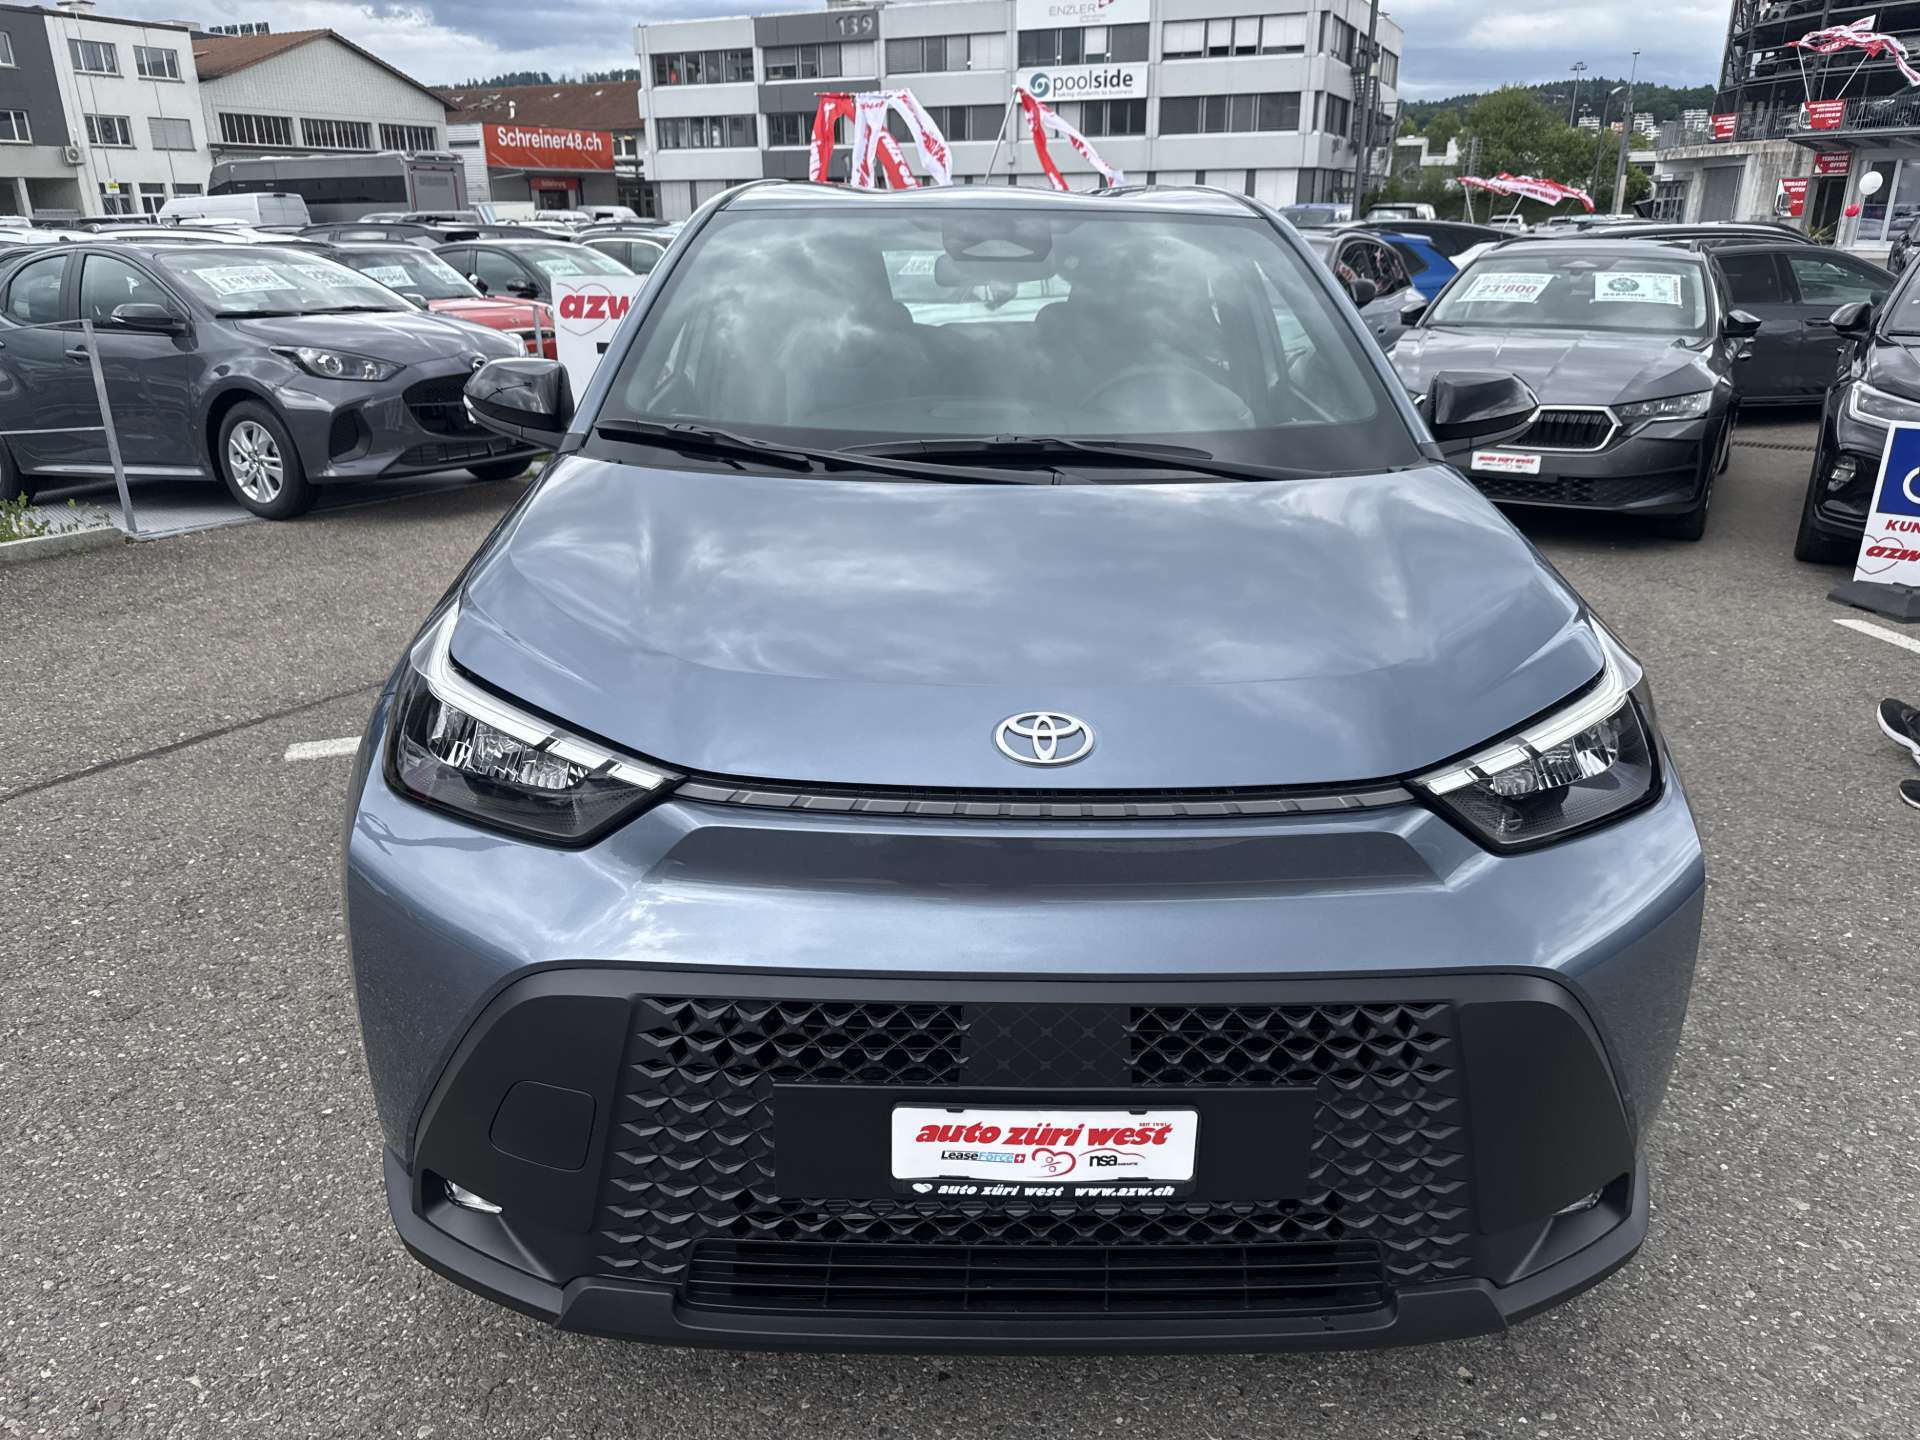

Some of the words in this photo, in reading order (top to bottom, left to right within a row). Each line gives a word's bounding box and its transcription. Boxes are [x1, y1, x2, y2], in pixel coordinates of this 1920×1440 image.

[1048, 3, 1096, 17] ENZLER
[836, 15, 873, 36] 139
[1053, 69, 1133, 97] poolside
[498, 127, 602, 151] Schreiner48.ch
[915, 1121, 1001, 1144] auto
[1001, 1122, 1085, 1146] züri
[1088, 1123, 1173, 1146] west
[941, 1150, 1014, 1163] LeaseForce
[1089, 1155, 1118, 1167] nsa
[938, 1185, 978, 1195] auto
[981, 1184, 1020, 1196] züri
[1024, 1186, 1064, 1197] west
[1074, 1186, 1175, 1197] www.azw.ch
